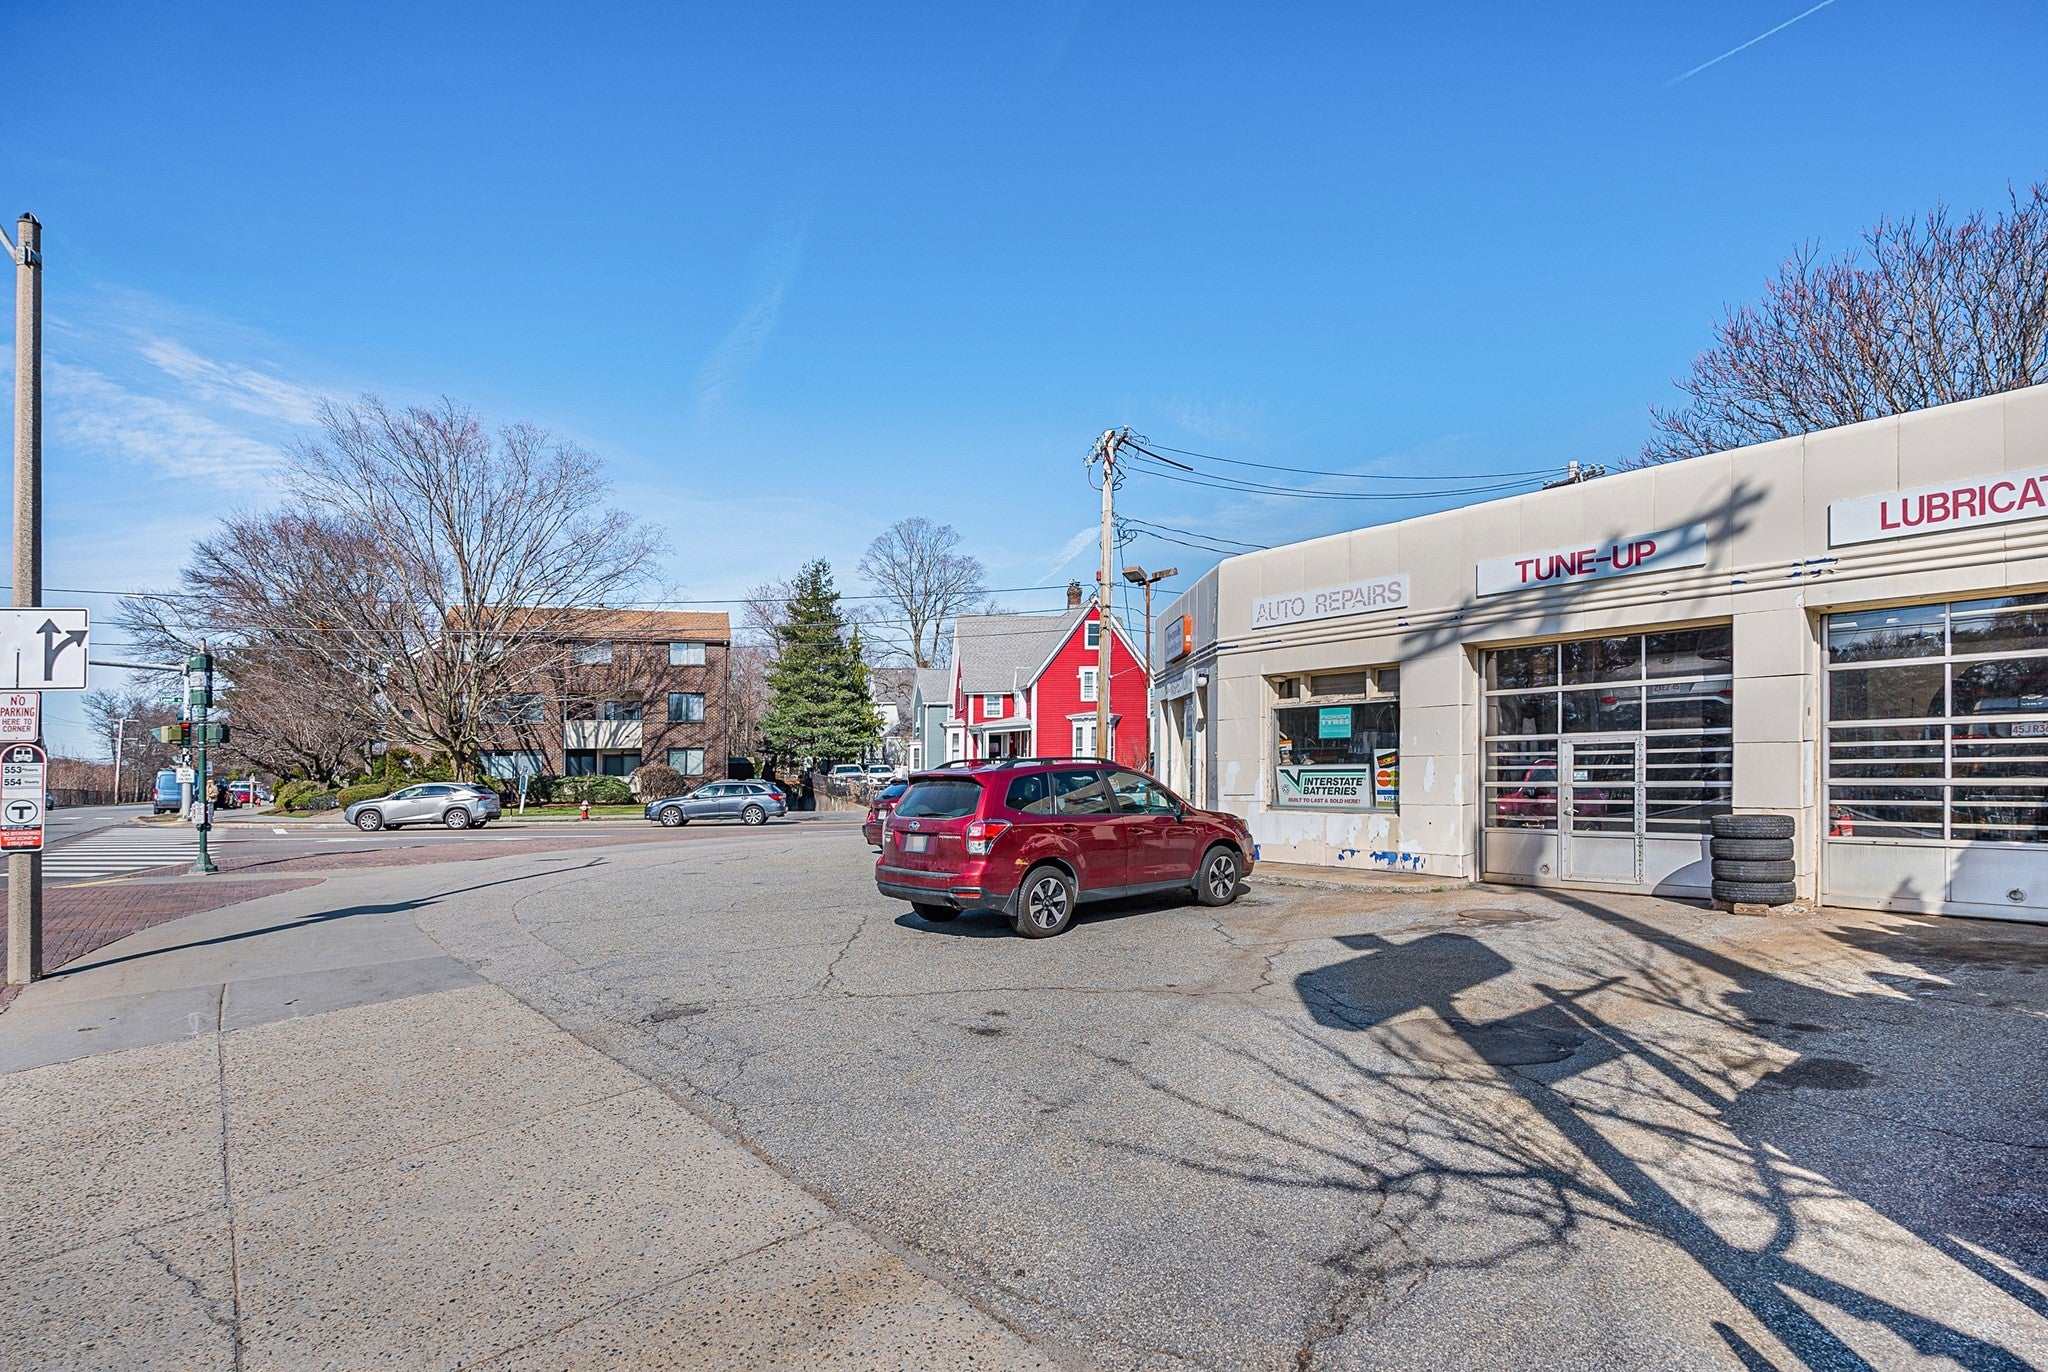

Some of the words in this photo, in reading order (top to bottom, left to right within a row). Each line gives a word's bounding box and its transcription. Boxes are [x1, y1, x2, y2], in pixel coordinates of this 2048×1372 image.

[1514, 539, 1657, 583] TUNE-UP
[1255, 597, 1305, 623] AUTO
[1315, 581, 1402, 614] REPAIRS
[10, 696, 26, 706] NO
[0, 707, 35, 717] PARKING
[4, 766, 22, 774] 553
[4, 778, 21, 786] 554
[1304, 777, 1363, 786] INTERSTATE
[1303, 787, 1357, 795] BATTERIES
[11, 806, 32, 819] T
